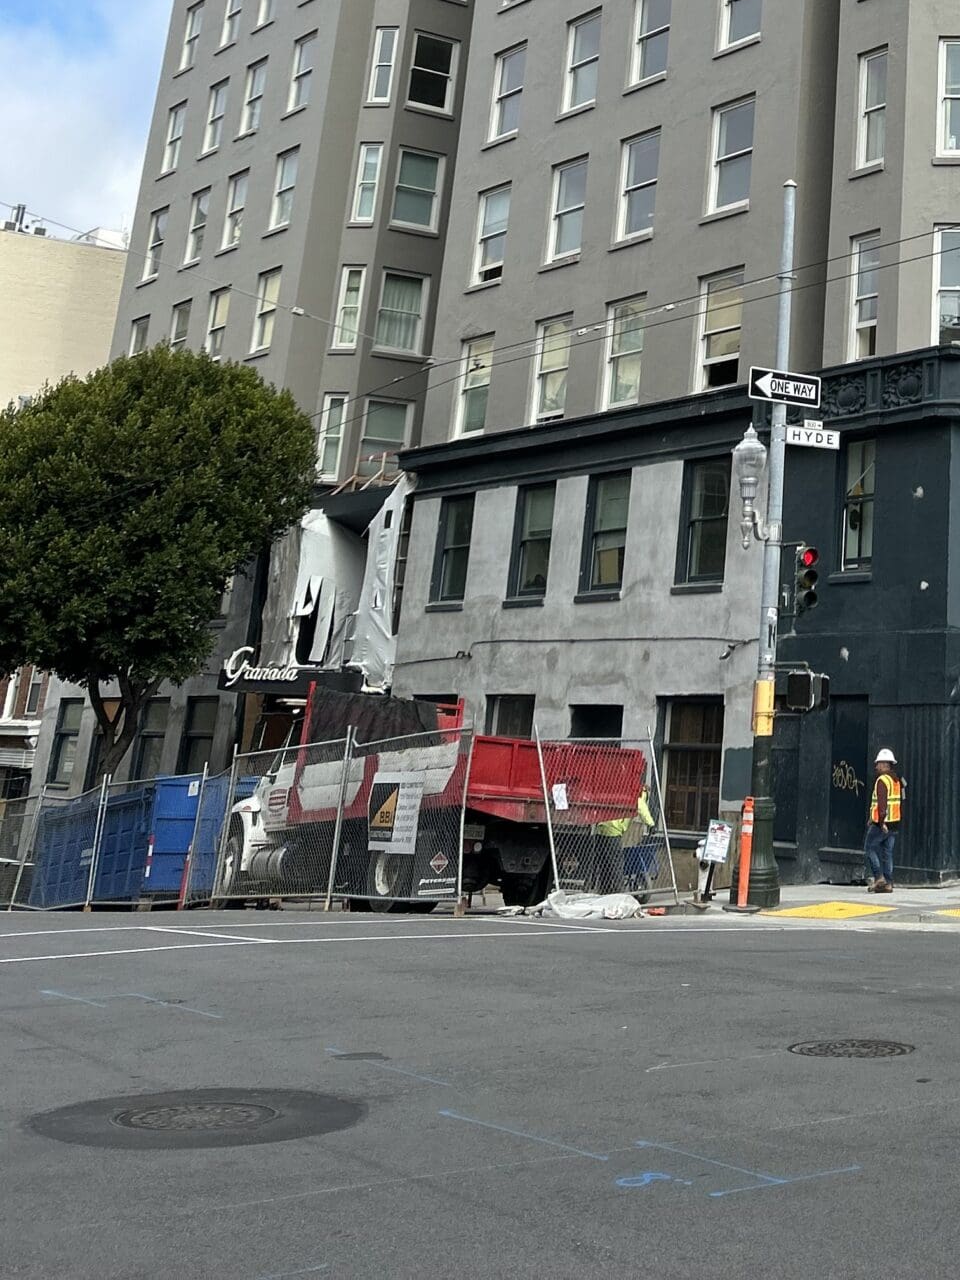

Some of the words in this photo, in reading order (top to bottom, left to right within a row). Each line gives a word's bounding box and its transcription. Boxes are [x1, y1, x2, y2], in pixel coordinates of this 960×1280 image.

[770, 379, 790, 394] ONE
[793, 383, 814, 397] WAY
[792, 430, 834, 445] HYDE
[224, 646, 299, 687] Granada
